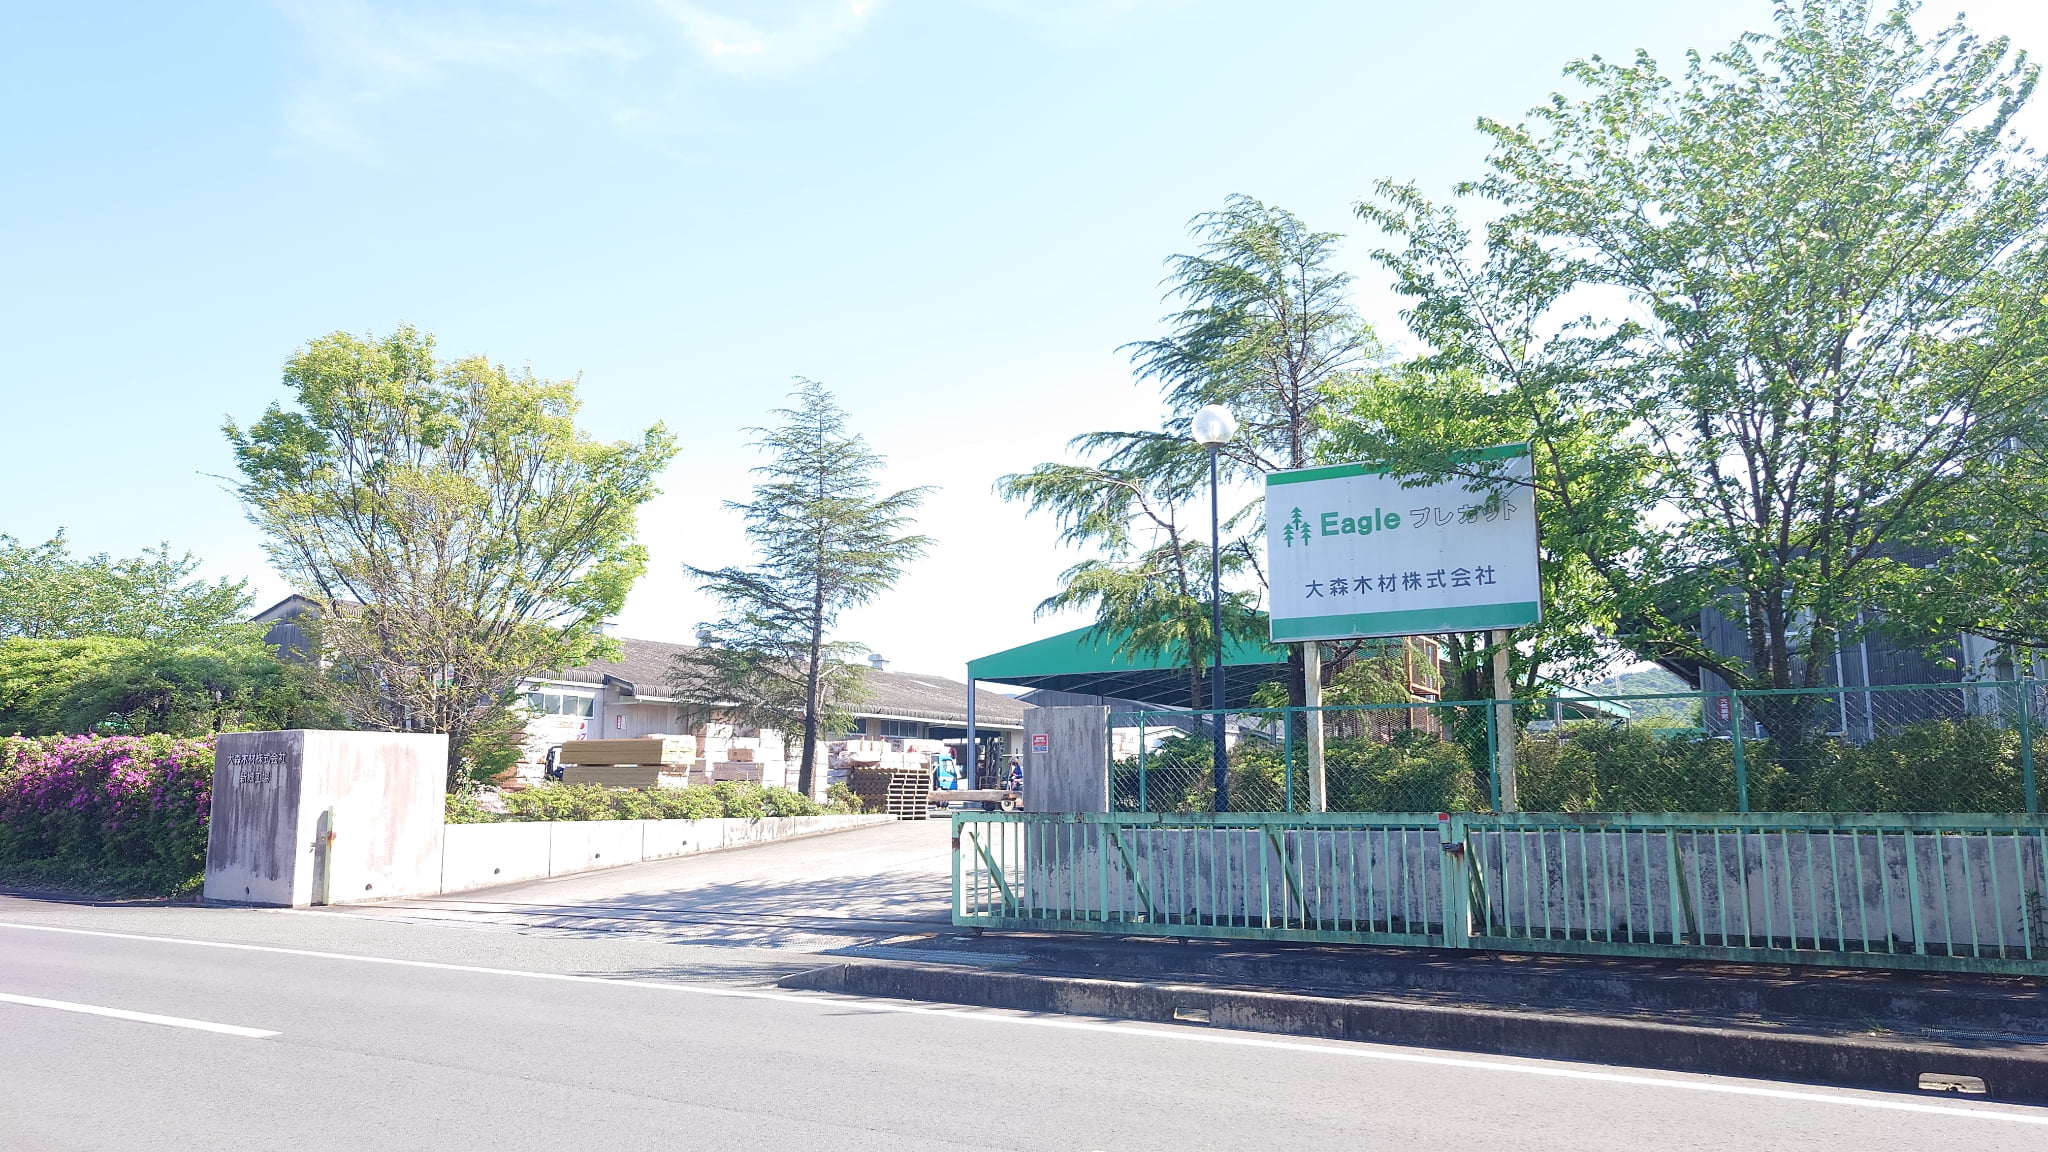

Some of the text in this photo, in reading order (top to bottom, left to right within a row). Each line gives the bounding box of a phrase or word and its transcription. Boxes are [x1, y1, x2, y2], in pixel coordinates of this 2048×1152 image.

[1321, 507, 1401, 536] Eagle
[1305, 565, 1497, 599] 大森木材株式会社
[227, 752, 287, 766] 大森木材株式会社
